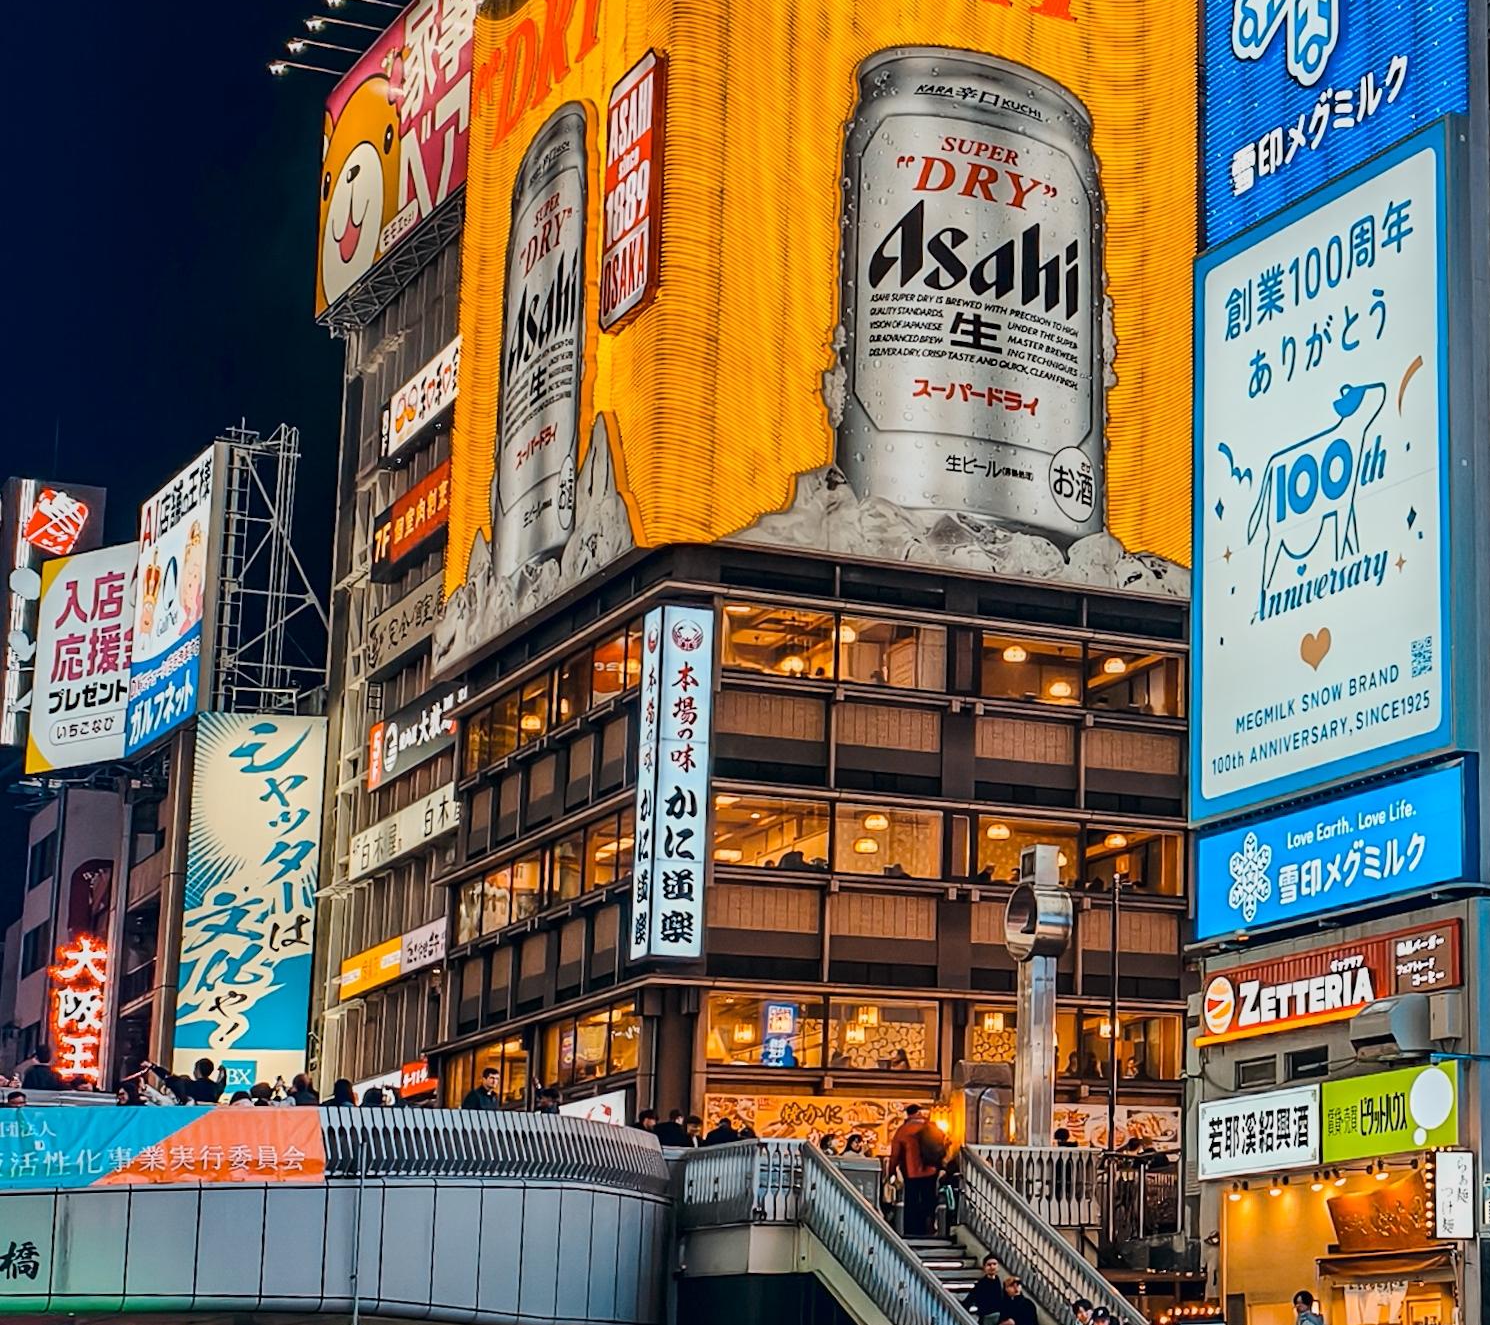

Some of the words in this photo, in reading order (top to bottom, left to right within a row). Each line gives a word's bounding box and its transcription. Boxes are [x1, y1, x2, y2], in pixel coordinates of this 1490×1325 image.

[607, 72, 653, 163] ASAHI
[914, 83, 954, 97] KARA
[1001, 98, 1045, 120] KUCHI
[1231, 55, 1408, 196] 雪印メグミルク
[941, 135, 1019, 167] SUPER
[533, 191, 561, 227] SUPER
[605, 159, 651, 247] 1889
[603, 227, 647, 318] OSAKA
[868, 199, 1080, 320] Asahi
[1224, 198, 1414, 342] 創業100周年
[507, 247, 578, 387] Asahi
[891, 293, 915, 302] SUPER
[917, 294, 933, 302] DRY
[945, 297, 982, 310] BREWED
[984, 303, 1007, 315] WITH
[1008, 308, 1051, 327] PRECISION
[949, 311, 1003, 356] 生
[1007, 321, 1038, 335] UNDER
[1040, 330, 1056, 342] THE
[946, 351, 975, 363] TASTE
[976, 356, 998, 366] AND
[1007, 336, 1043, 351] MASTER
[1007, 348, 1025, 360] ING
[1026, 353, 1078, 377] TECHNIQUES
[1249, 289, 1387, 399] ありがとう
[912, 379, 1039, 417] スーパードライ
[1052, 469, 1094, 508] お酒
[1276, 435, 1387, 523] 100th
[55, 571, 126, 630] 入店
[1250, 549, 1388, 625] Anniversary
[48, 680, 128, 715] プレゼント
[129, 669, 194, 746] ガルフネット
[671, 661, 700, 774] 本場の味
[1236, 698, 1295, 734] MEGMILK
[1302, 683, 1343, 712] SNOW
[1349, 664, 1399, 697] BRAND
[56, 715, 115, 739] いちこなび
[1212, 749, 1244, 775] 100th
[1288, 831, 1313, 850] Love
[1316, 820, 1354, 841] Earth.
[1358, 809, 1386, 830] Love
[1389, 798, 1417, 821] Life.
[1278, 831, 1426, 905] 雪印メグミルク
[55, 936, 109, 1082] 大阪王
[1238, 967, 1375, 1027] ZETTERIA
[226, 1067, 252, 1086] BX
[0, 1145, 306, 1178] 活性化事業実行委員会
[0, 1241, 40, 1280] 橋
